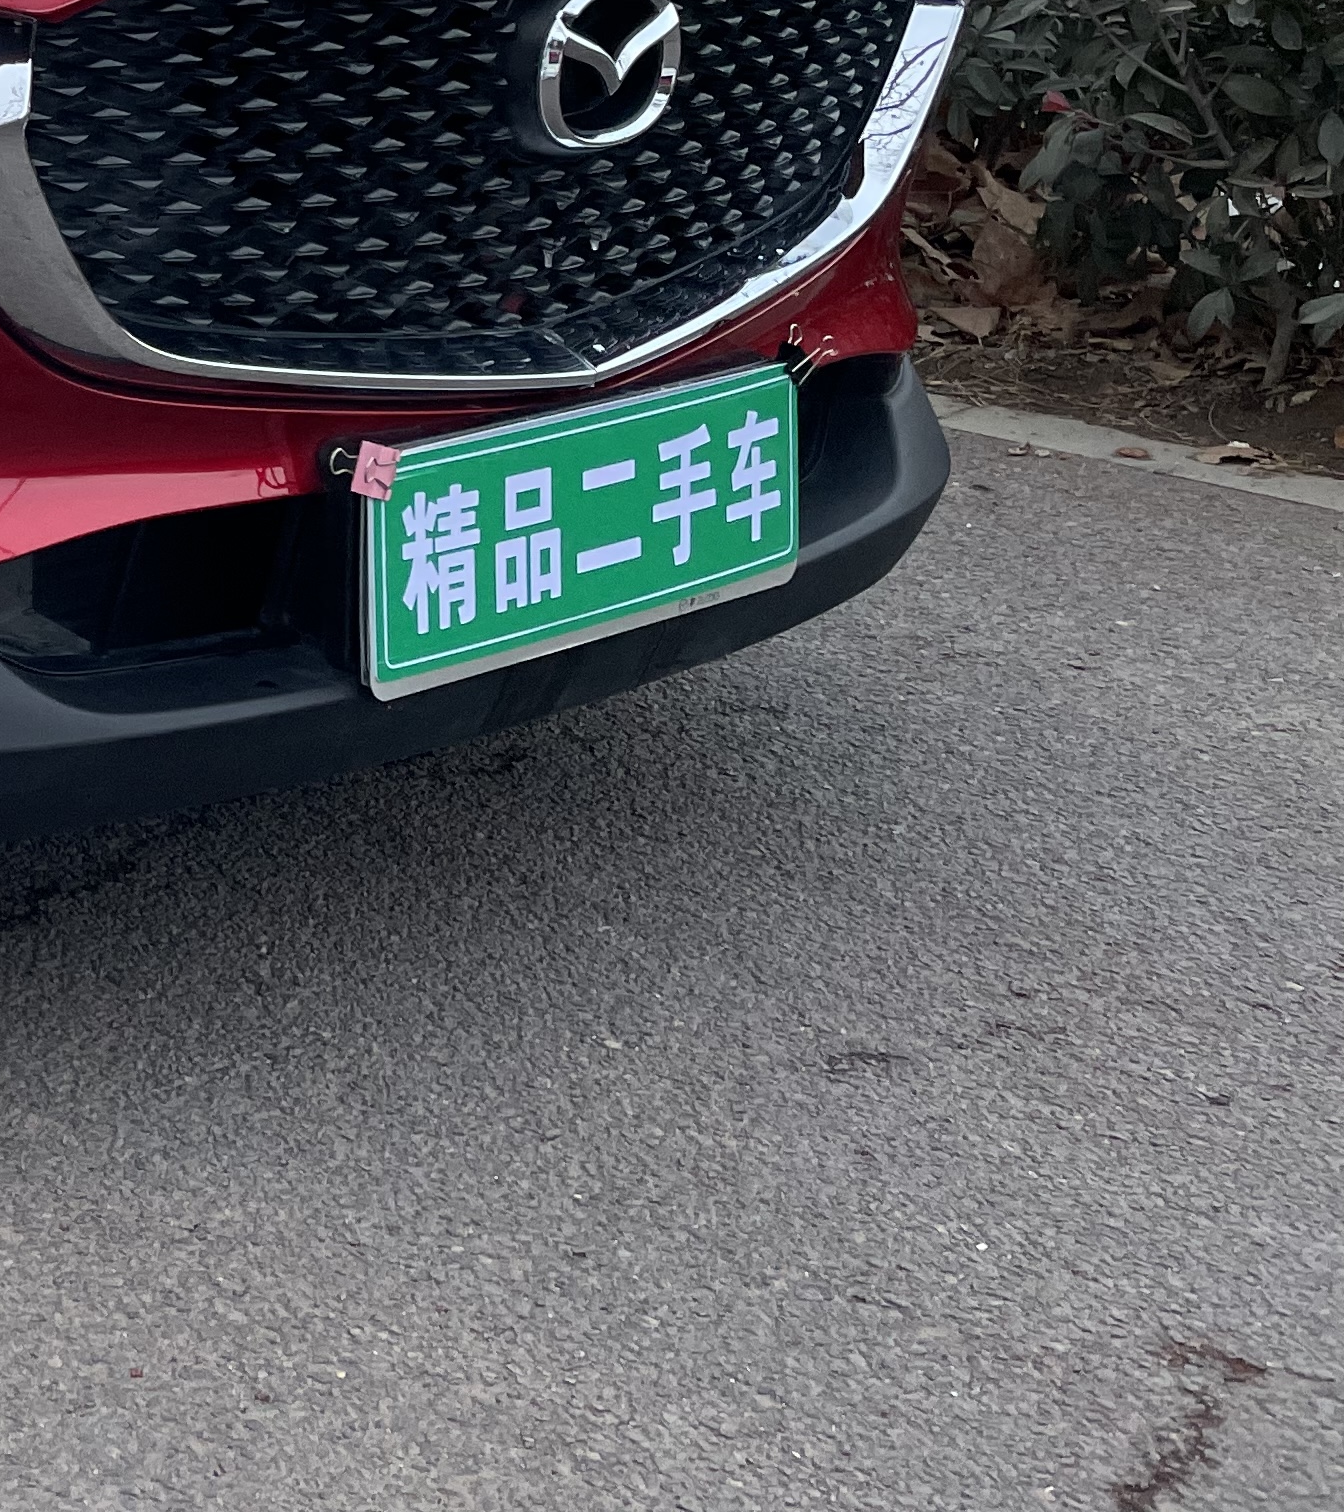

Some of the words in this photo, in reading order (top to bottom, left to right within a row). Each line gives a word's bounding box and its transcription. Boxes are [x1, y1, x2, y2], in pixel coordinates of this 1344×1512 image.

[402, 410, 781, 635] 精品二手车
